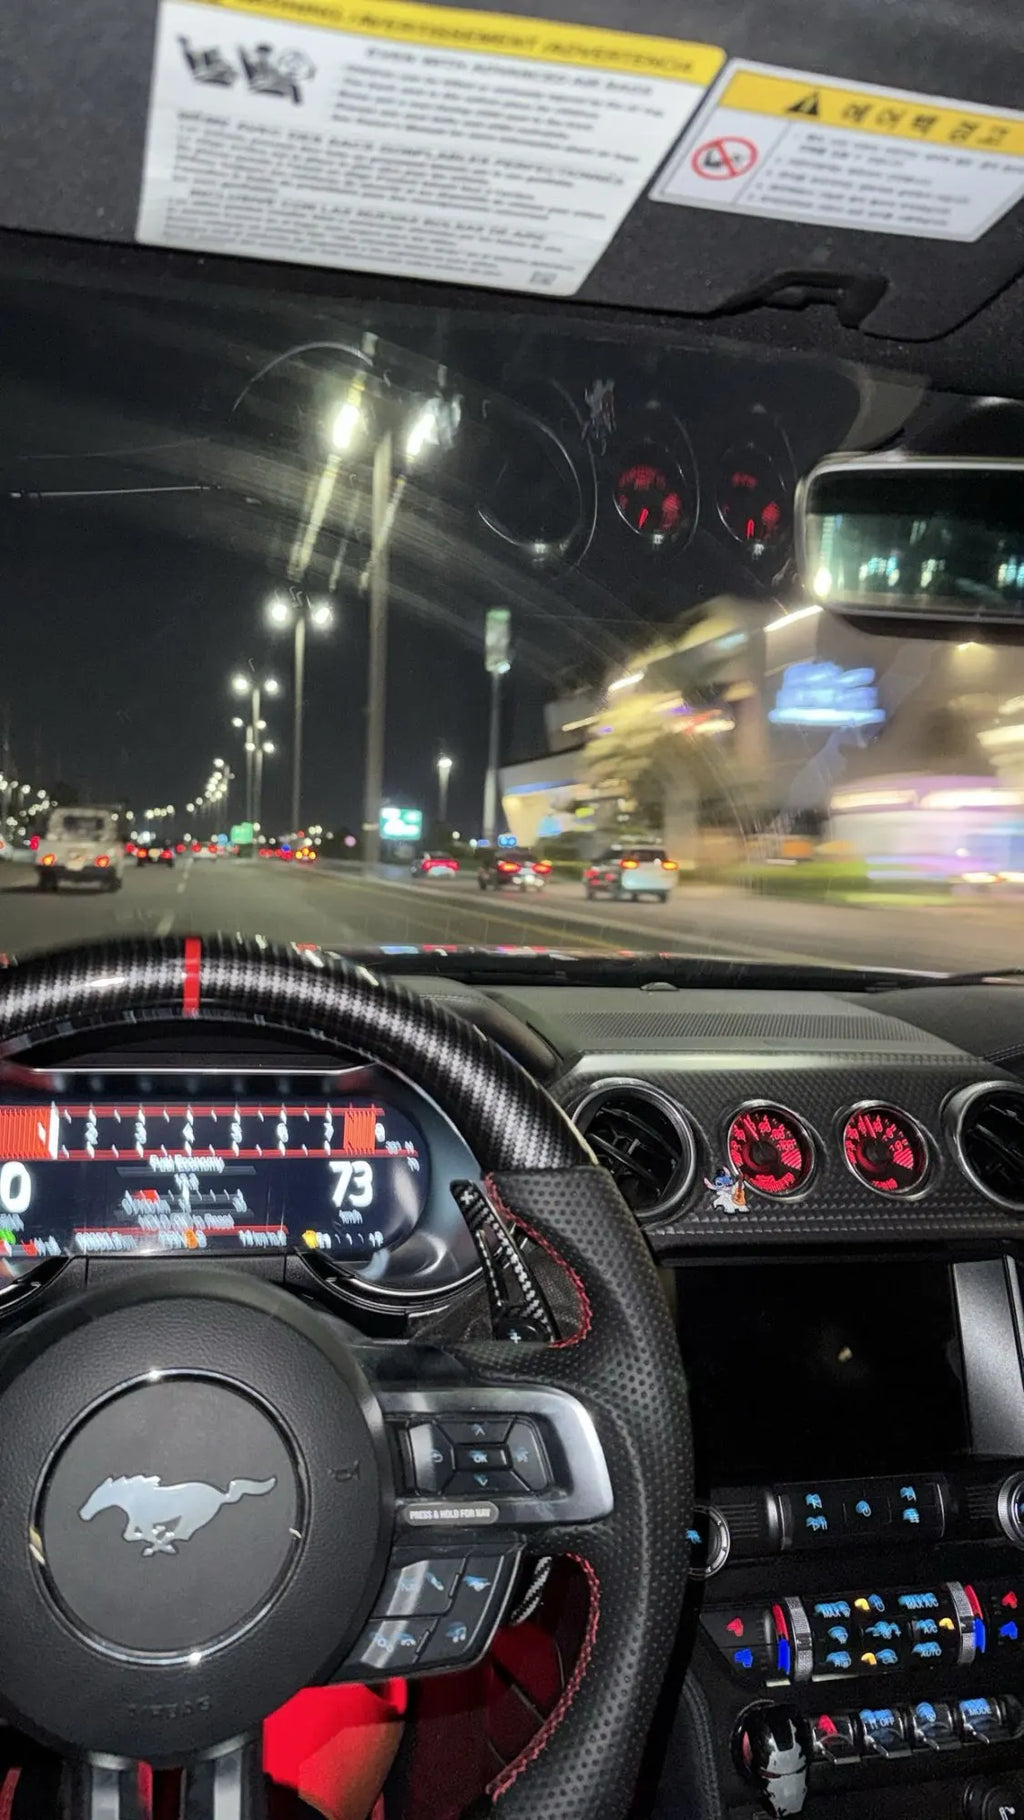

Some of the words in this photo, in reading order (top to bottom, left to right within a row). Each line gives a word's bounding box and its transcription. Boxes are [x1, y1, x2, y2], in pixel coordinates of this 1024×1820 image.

[328, 1160, 373, 1208] 73
[409, 1510, 433, 1520] PRESS
[440, 1509, 459, 1519] HOLD
[460, 1508, 475, 1518] FOR
